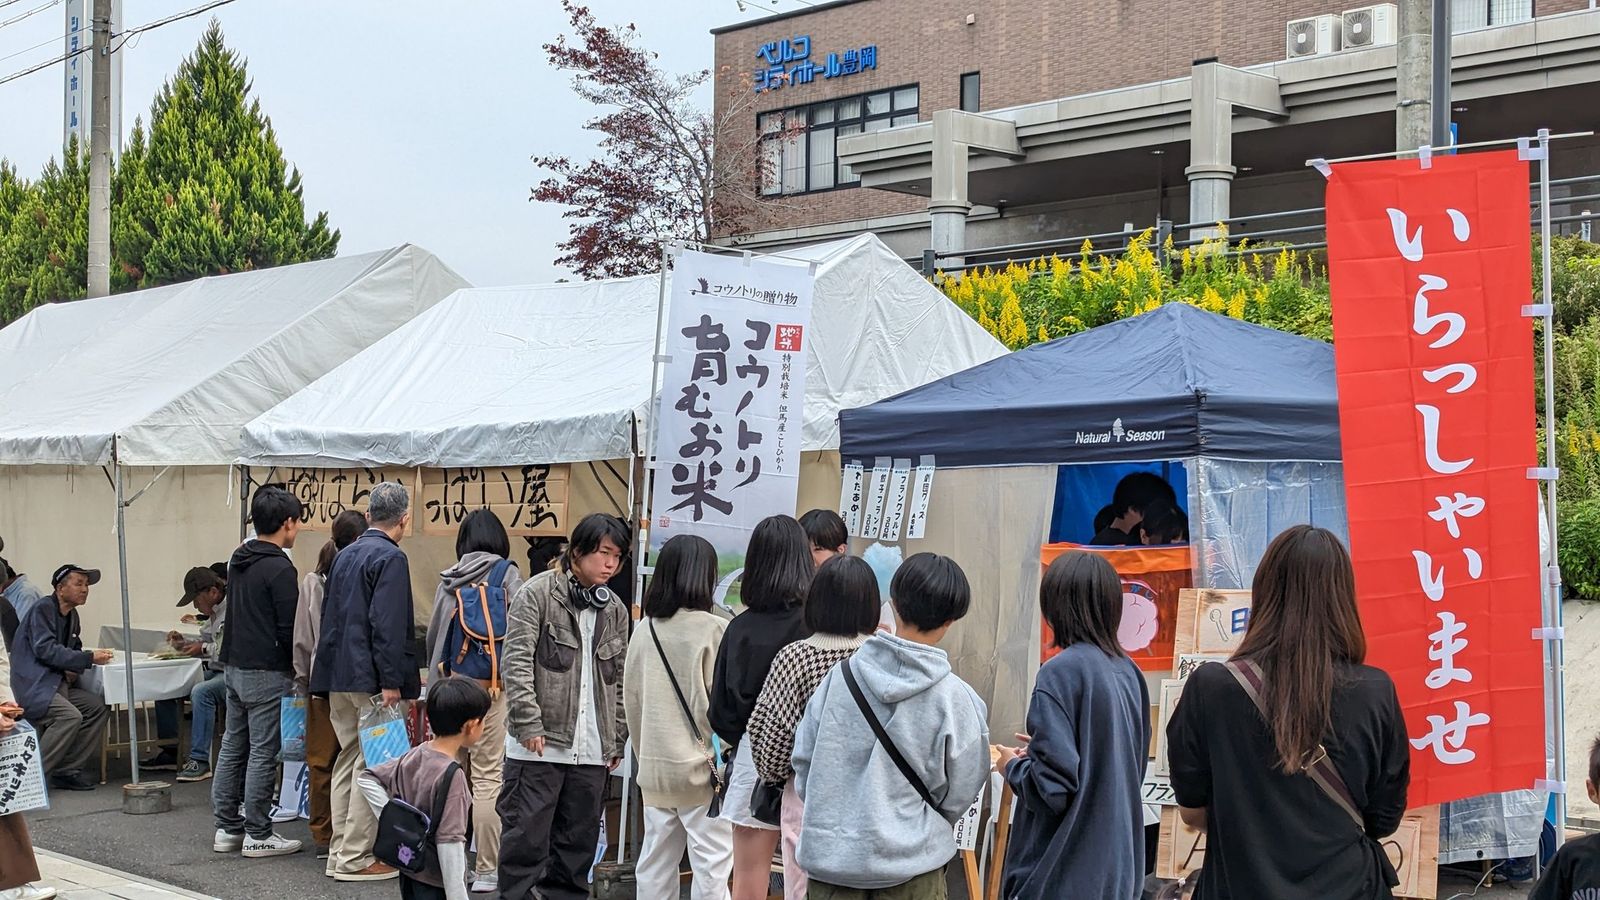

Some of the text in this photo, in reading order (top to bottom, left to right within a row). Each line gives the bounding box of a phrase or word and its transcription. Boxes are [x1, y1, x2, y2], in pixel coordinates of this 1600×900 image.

[70, 16, 79, 128] シティホール
[754, 45, 877, 92] シティホール豊岡
[756, 35, 811, 65] ベルコ
[713, 285, 798, 305] コウノトリの贈り物
[665, 314, 733, 522] 育むお米
[729, 319, 771, 492] コウノトリ
[1075, 429, 1165, 444] Natural Season
[1386, 208, 1490, 765] いらっしゃいませ
[243, 843, 276, 851] adidas
